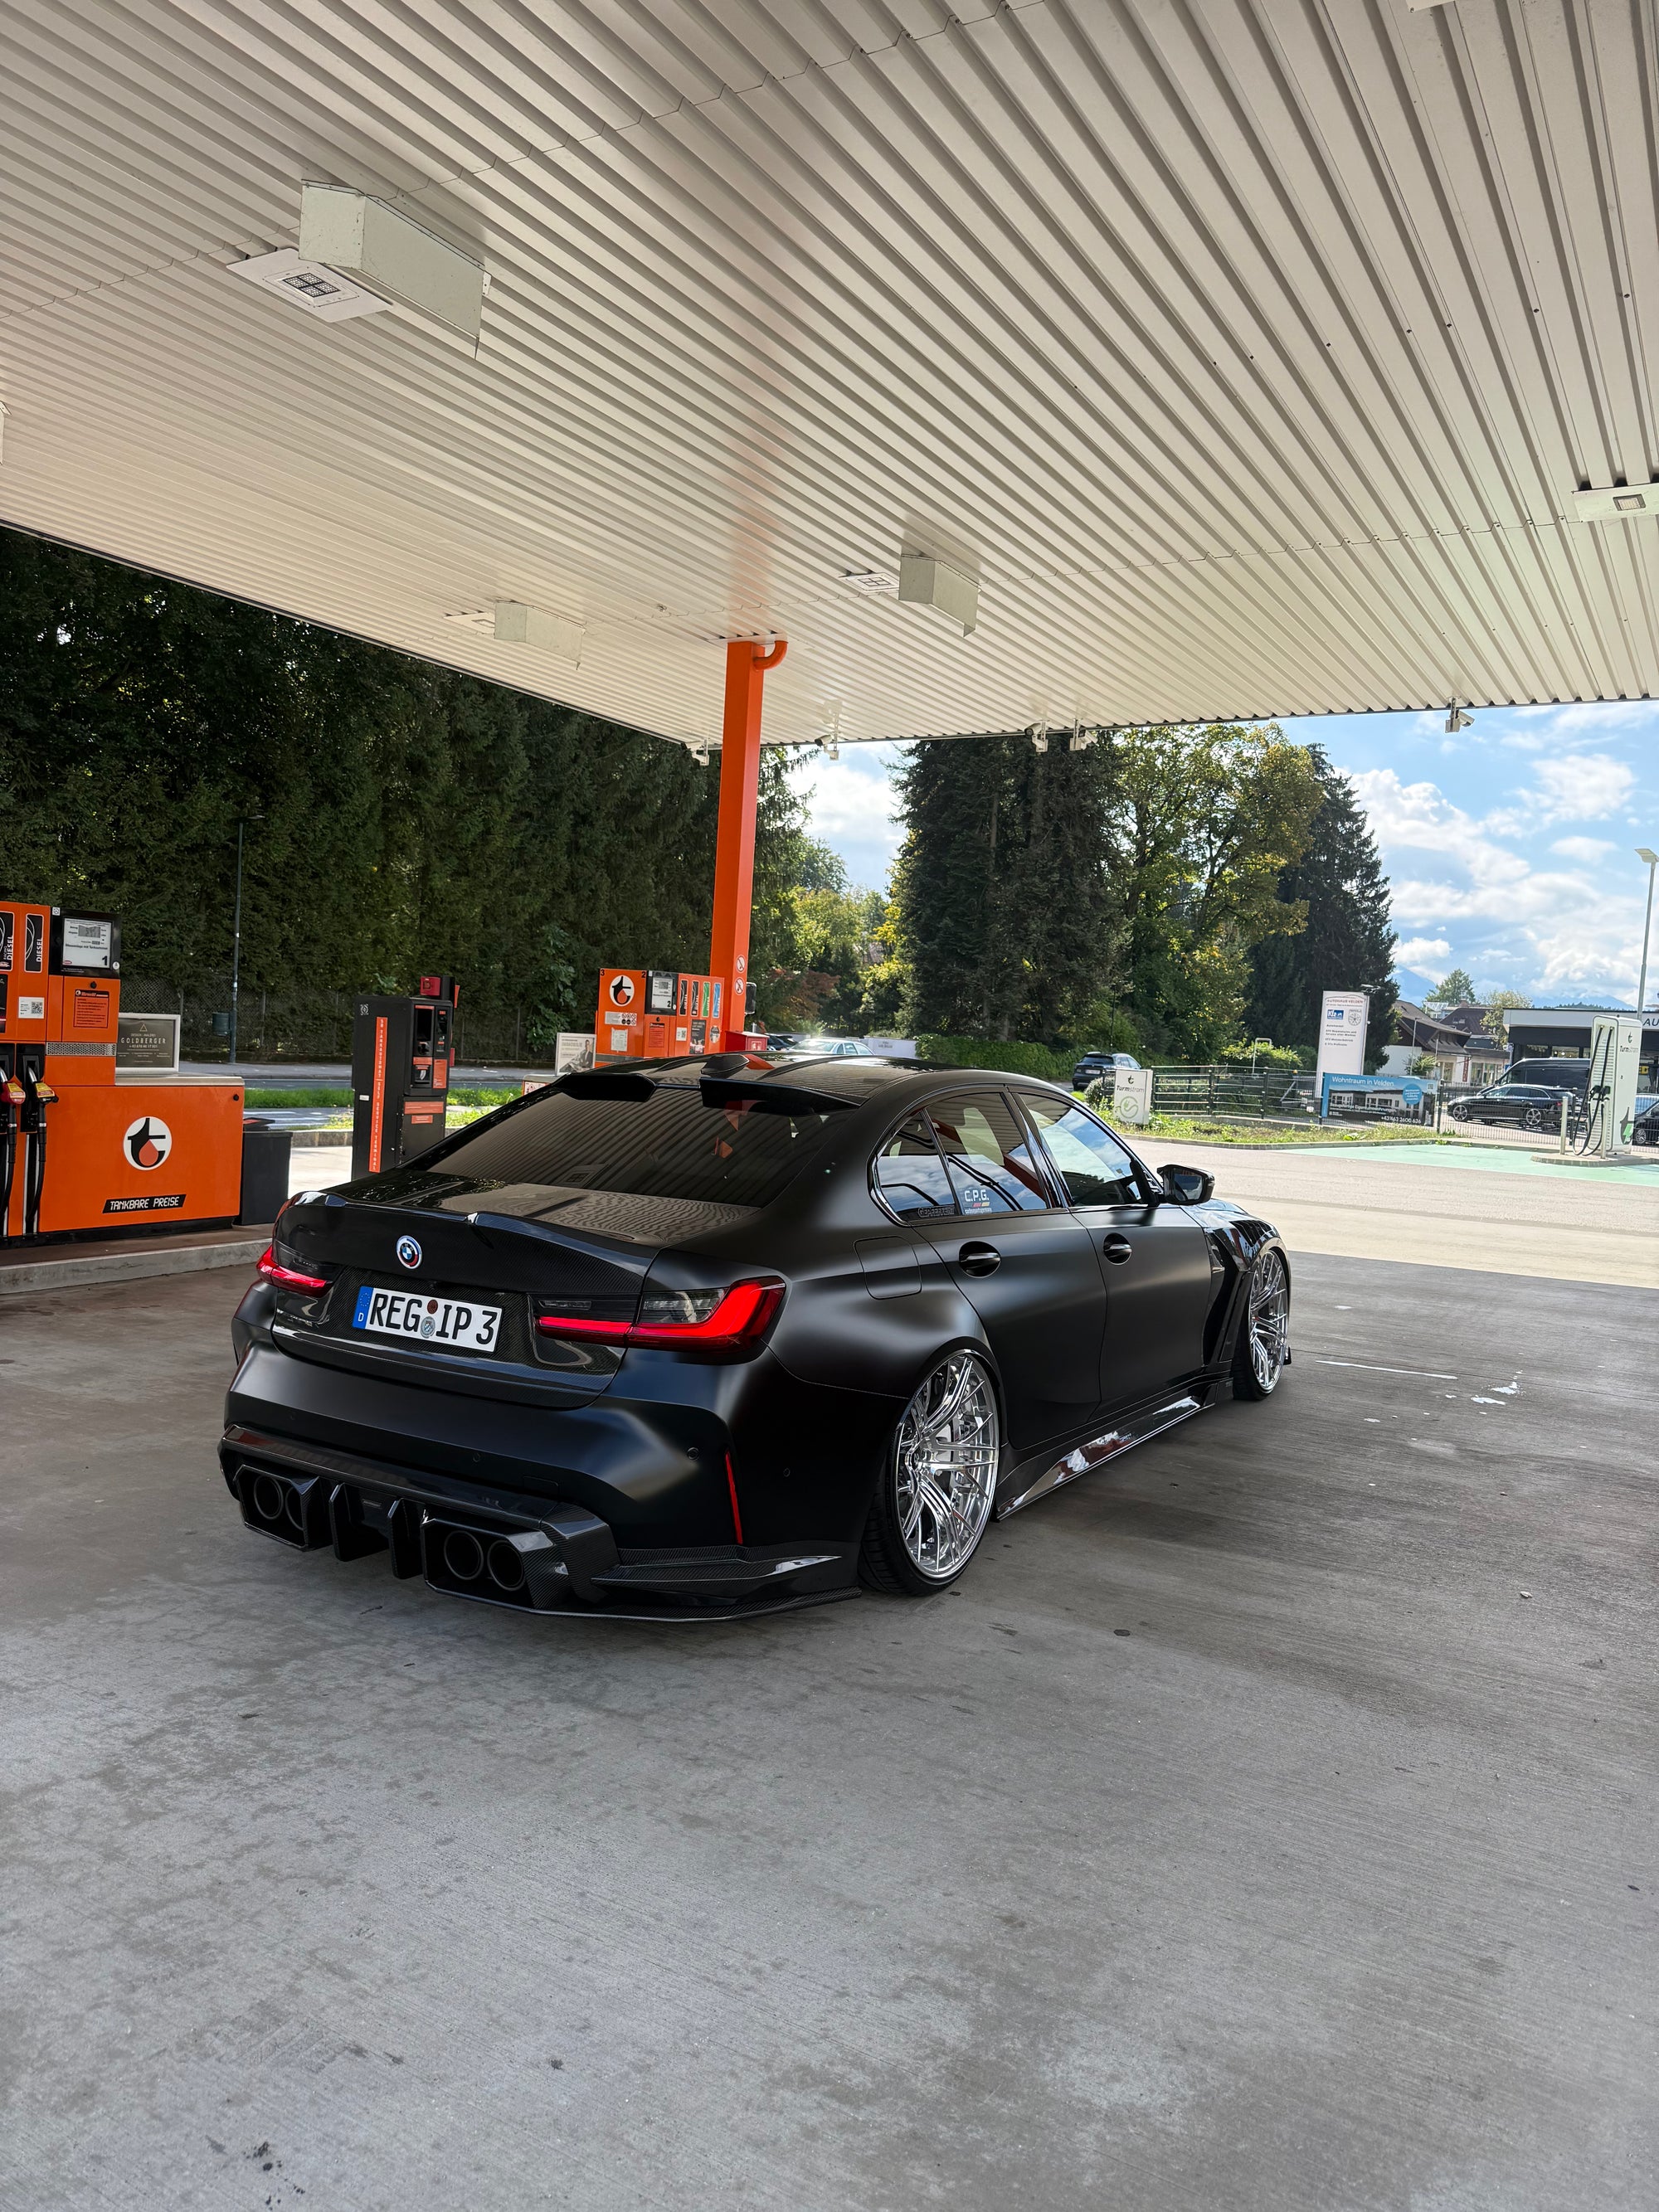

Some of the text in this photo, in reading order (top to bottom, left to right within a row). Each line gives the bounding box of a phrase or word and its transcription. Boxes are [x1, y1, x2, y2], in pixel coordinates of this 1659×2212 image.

[101, 955, 108, 966] 1
[1331, 1077, 1366, 1085] Wohntraum
[1117, 1085, 1144, 1093] Turmstrom
[964, 1189, 990, 1202] C.P.G.
[109, 1196, 180, 1211] TANKBARE PREISE
[358, 1312, 364, 1322] D
[369, 1293, 499, 1345] REG IP 3
